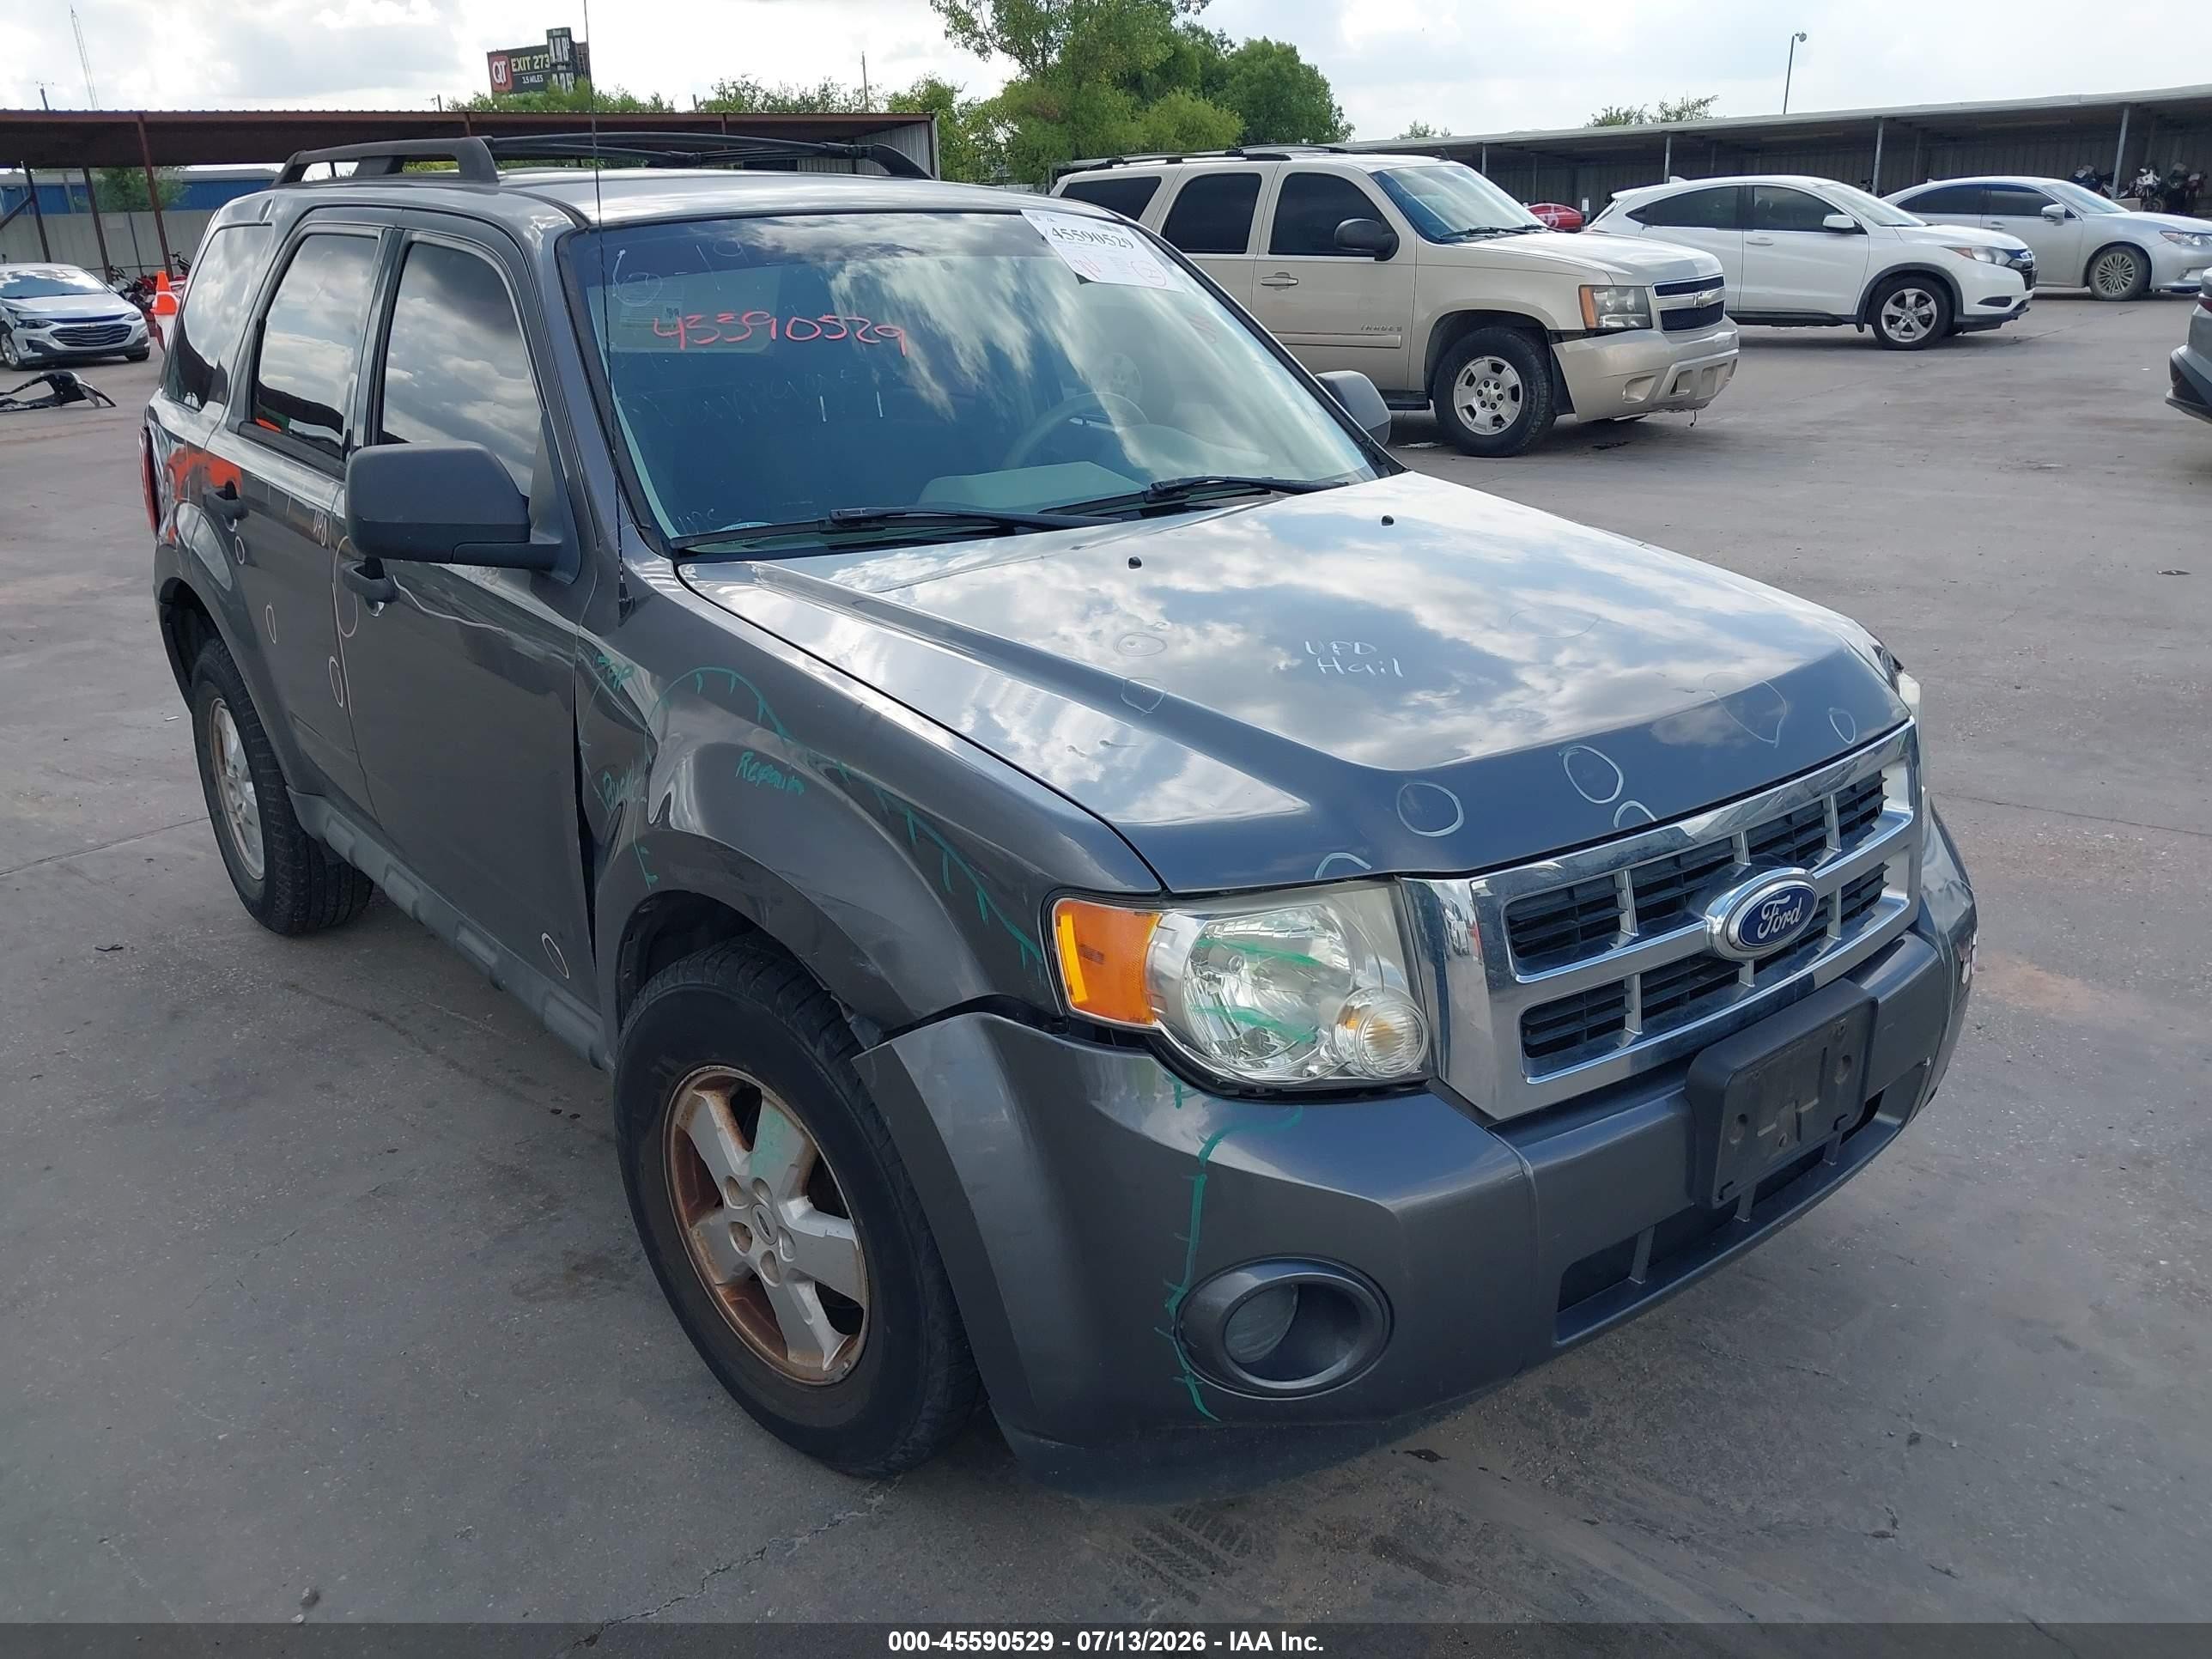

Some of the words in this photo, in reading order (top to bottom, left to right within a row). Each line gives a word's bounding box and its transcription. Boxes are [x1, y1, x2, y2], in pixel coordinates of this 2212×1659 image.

[492, 61, 507, 86] QT
[511, 56, 532, 72] EXIT
[533, 53, 550, 70] 273
[530, 75, 544, 83] MILES
[1052, 227, 1134, 250] 45590529
[1757, 894, 1803, 939] Ford
